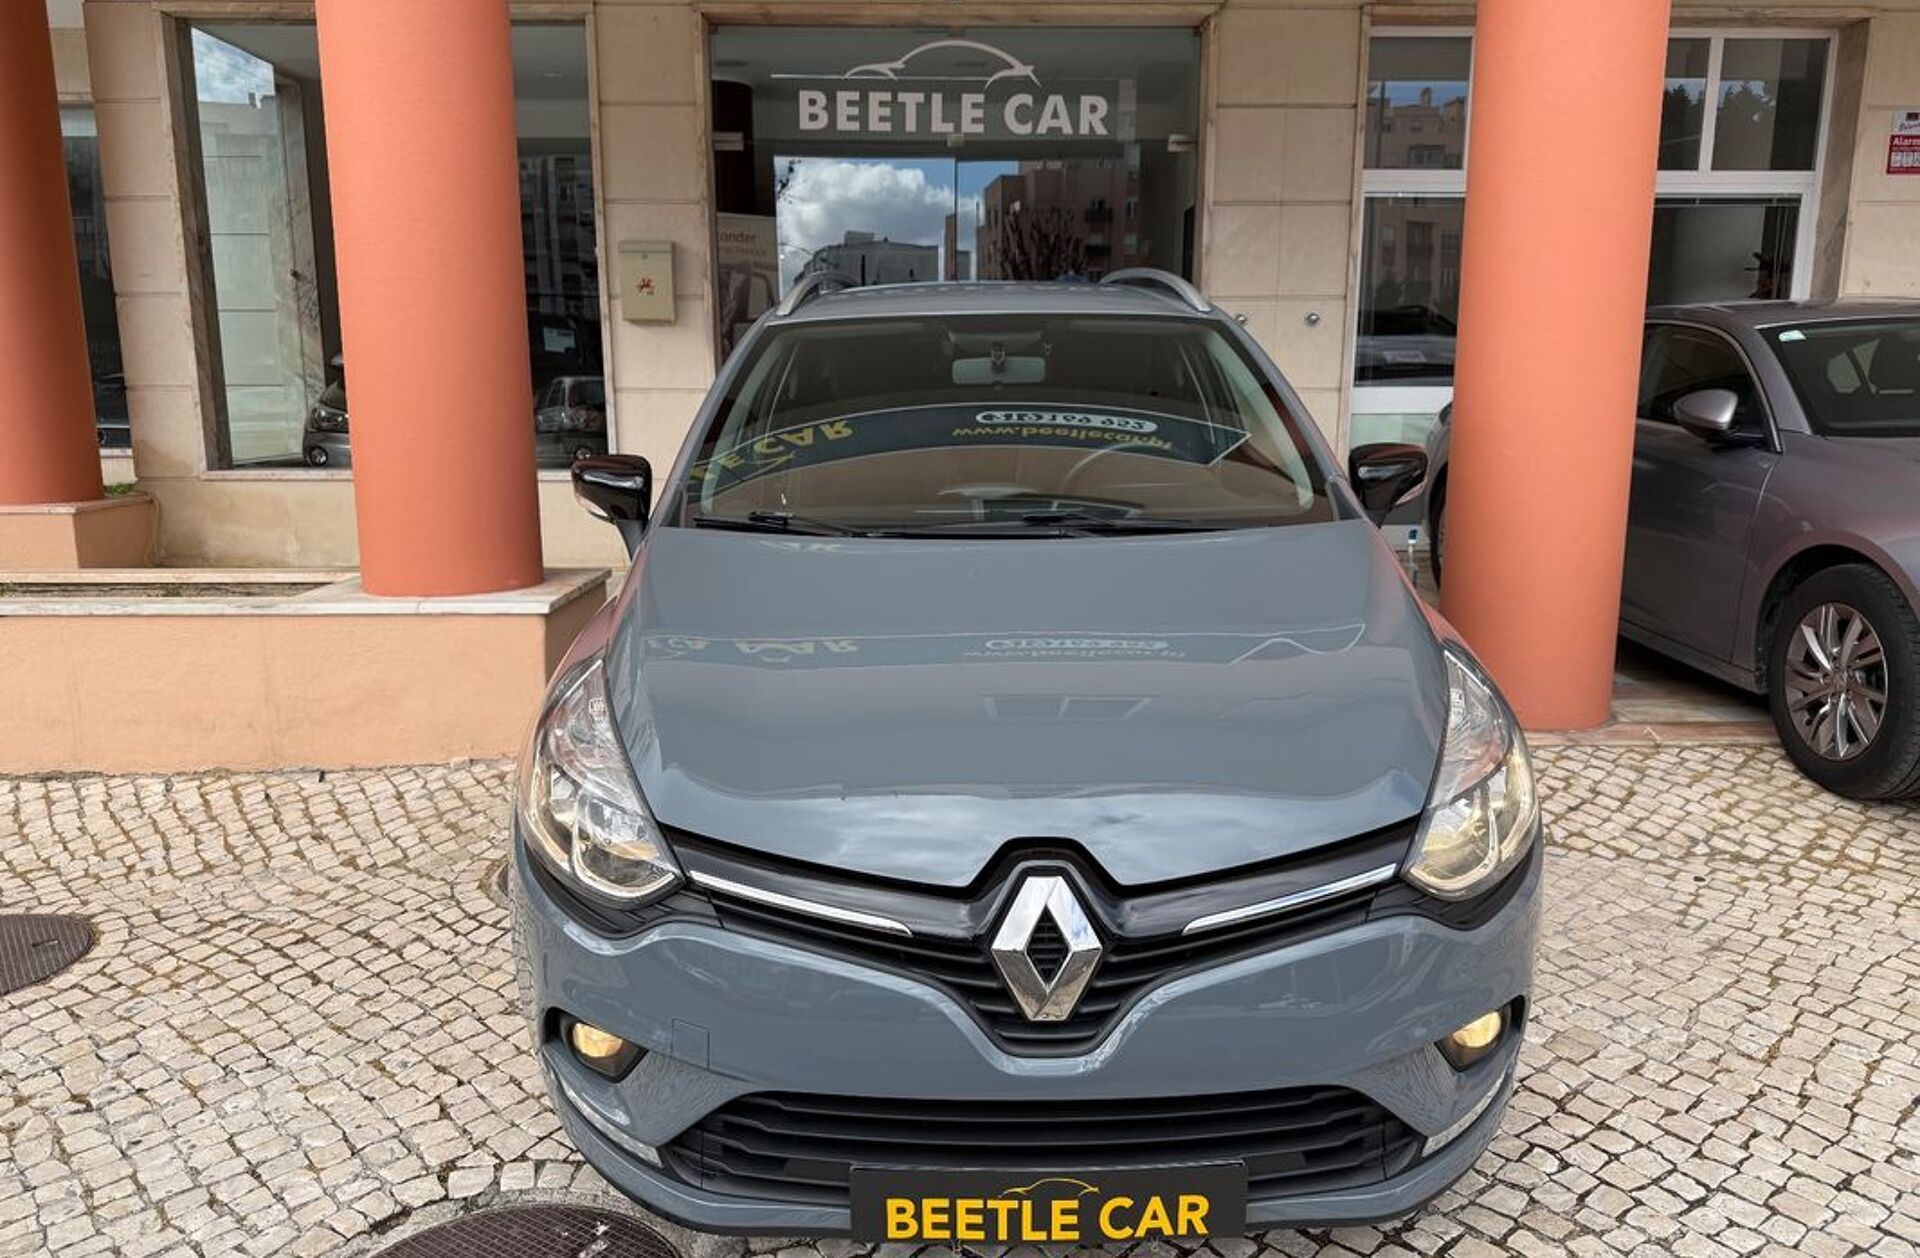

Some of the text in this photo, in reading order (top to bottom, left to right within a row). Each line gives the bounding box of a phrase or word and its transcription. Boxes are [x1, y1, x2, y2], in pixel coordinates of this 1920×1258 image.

[798, 89, 1110, 136] BEETLE CAR
[885, 1194, 1210, 1241] BEETLE CAR
